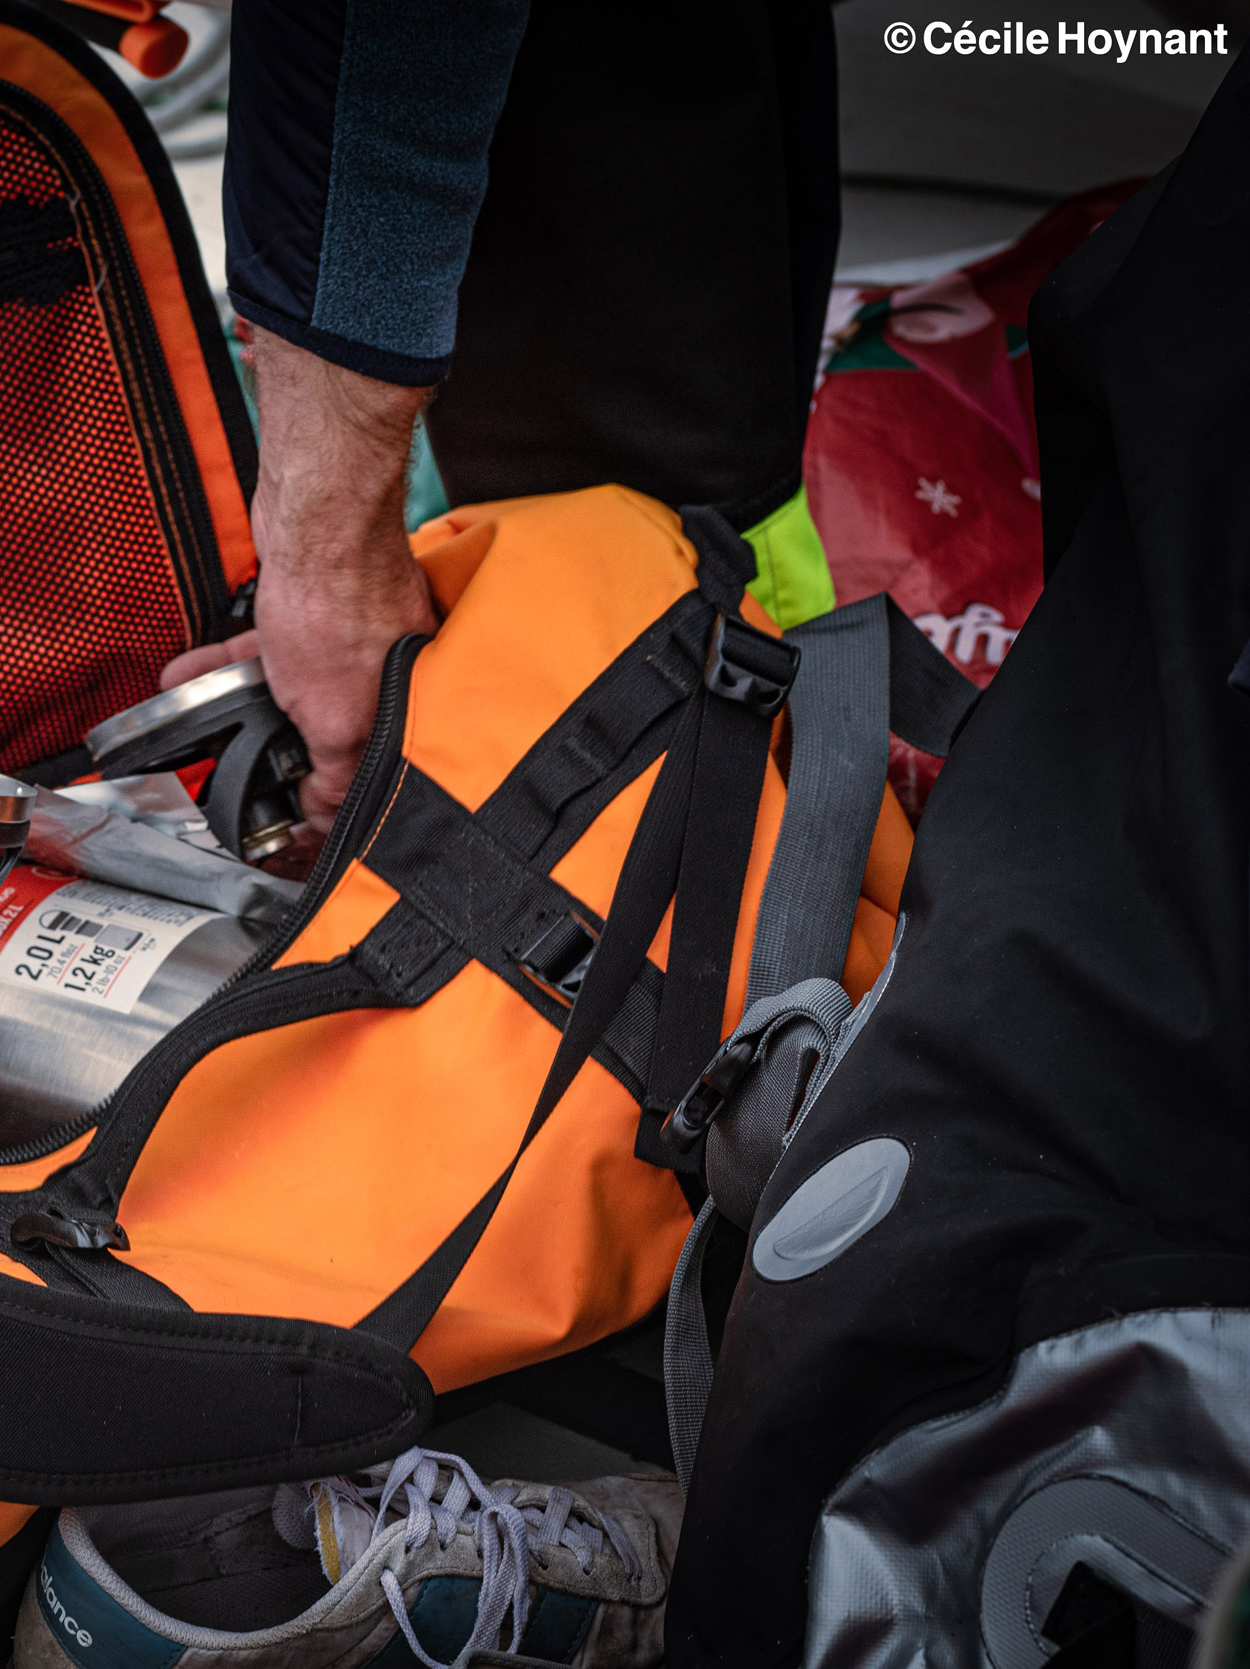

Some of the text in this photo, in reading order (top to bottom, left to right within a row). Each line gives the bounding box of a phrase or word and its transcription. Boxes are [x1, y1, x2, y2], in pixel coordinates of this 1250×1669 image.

[14, 933, 67, 982] 2,0 L
[79, 944, 116, 966] kg
[63, 966, 97, 992] 1,2
[41, 1565, 93, 1647] alance
